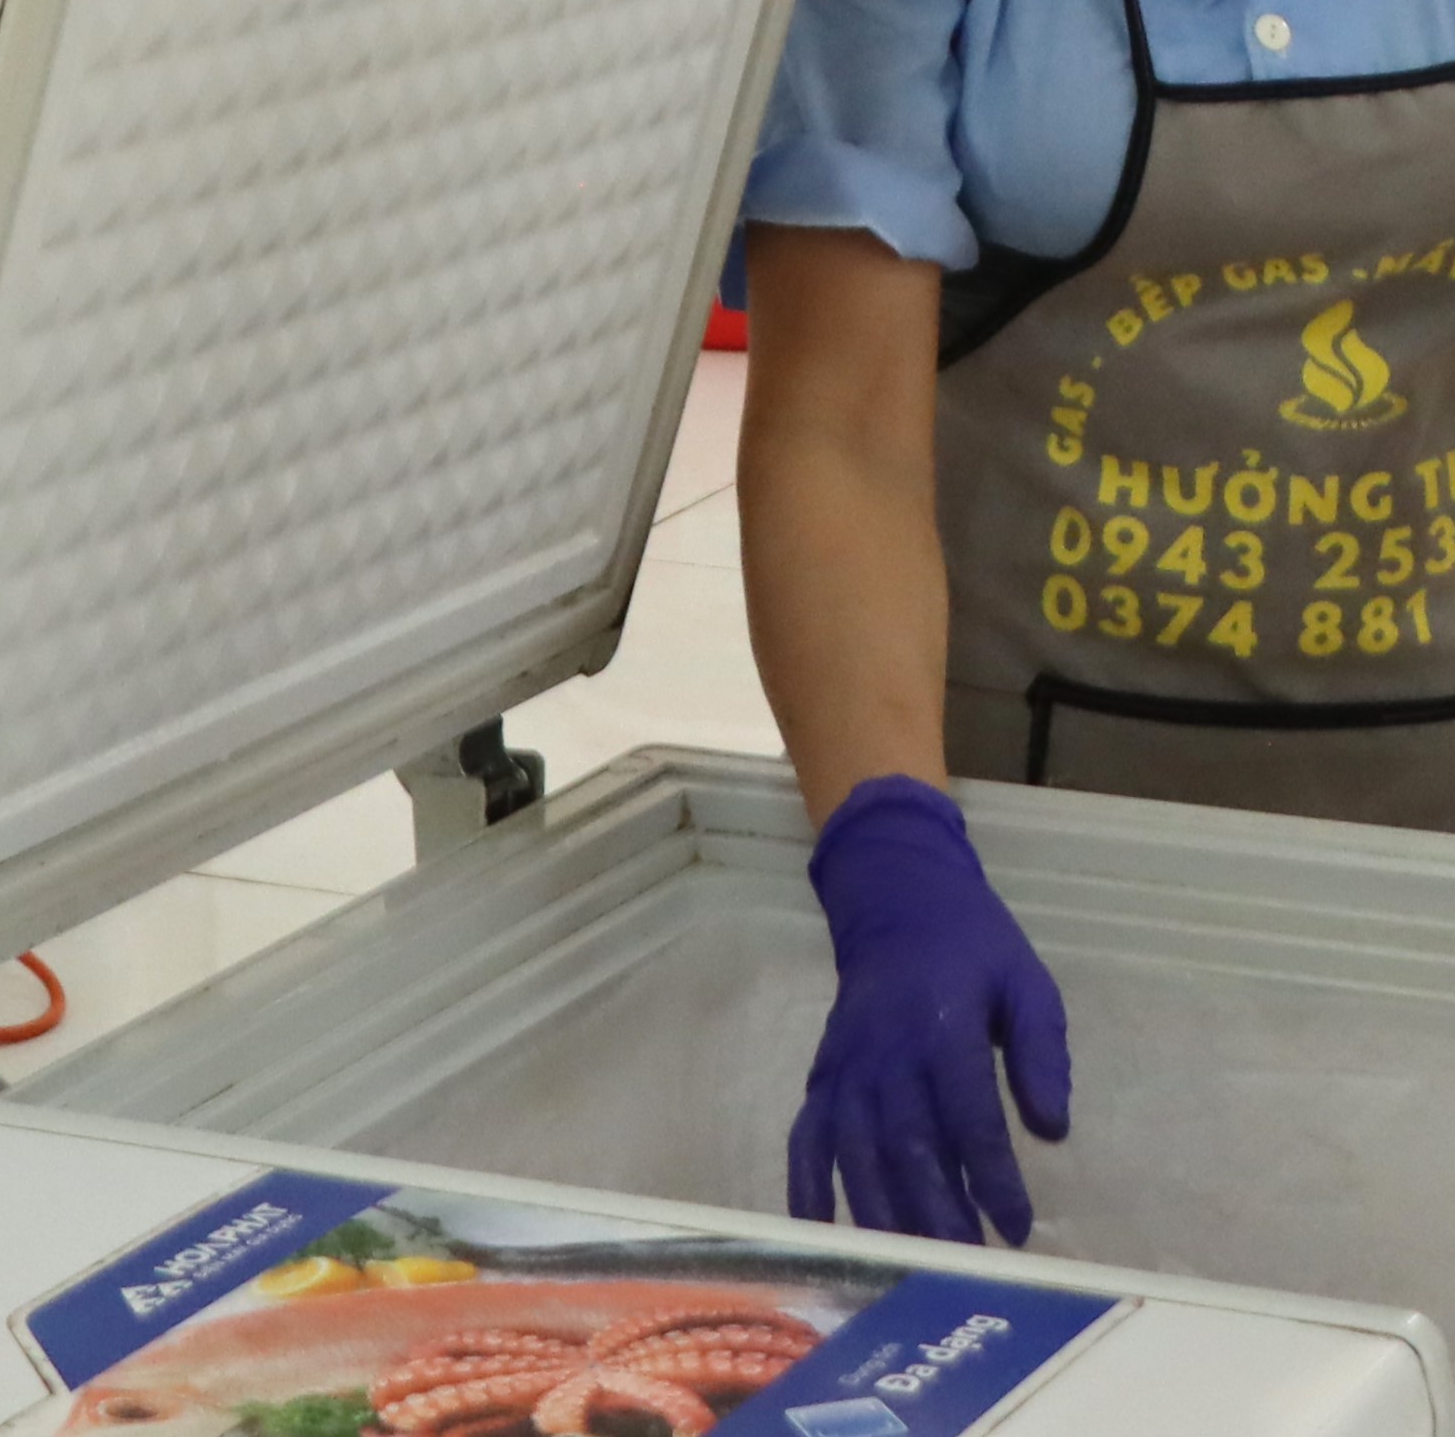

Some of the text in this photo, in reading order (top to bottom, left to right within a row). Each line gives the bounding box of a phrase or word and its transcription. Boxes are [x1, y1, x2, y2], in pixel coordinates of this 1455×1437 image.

[1046, 374, 1095, 466] GAS
[1221, 252, 1330, 292] GAS
[1097, 448, 1392, 525] HƯỞNG
[1049, 505, 1266, 590] 0943
[1041, 573, 1258, 658] 0374
[1298, 587, 1432, 657] 881
